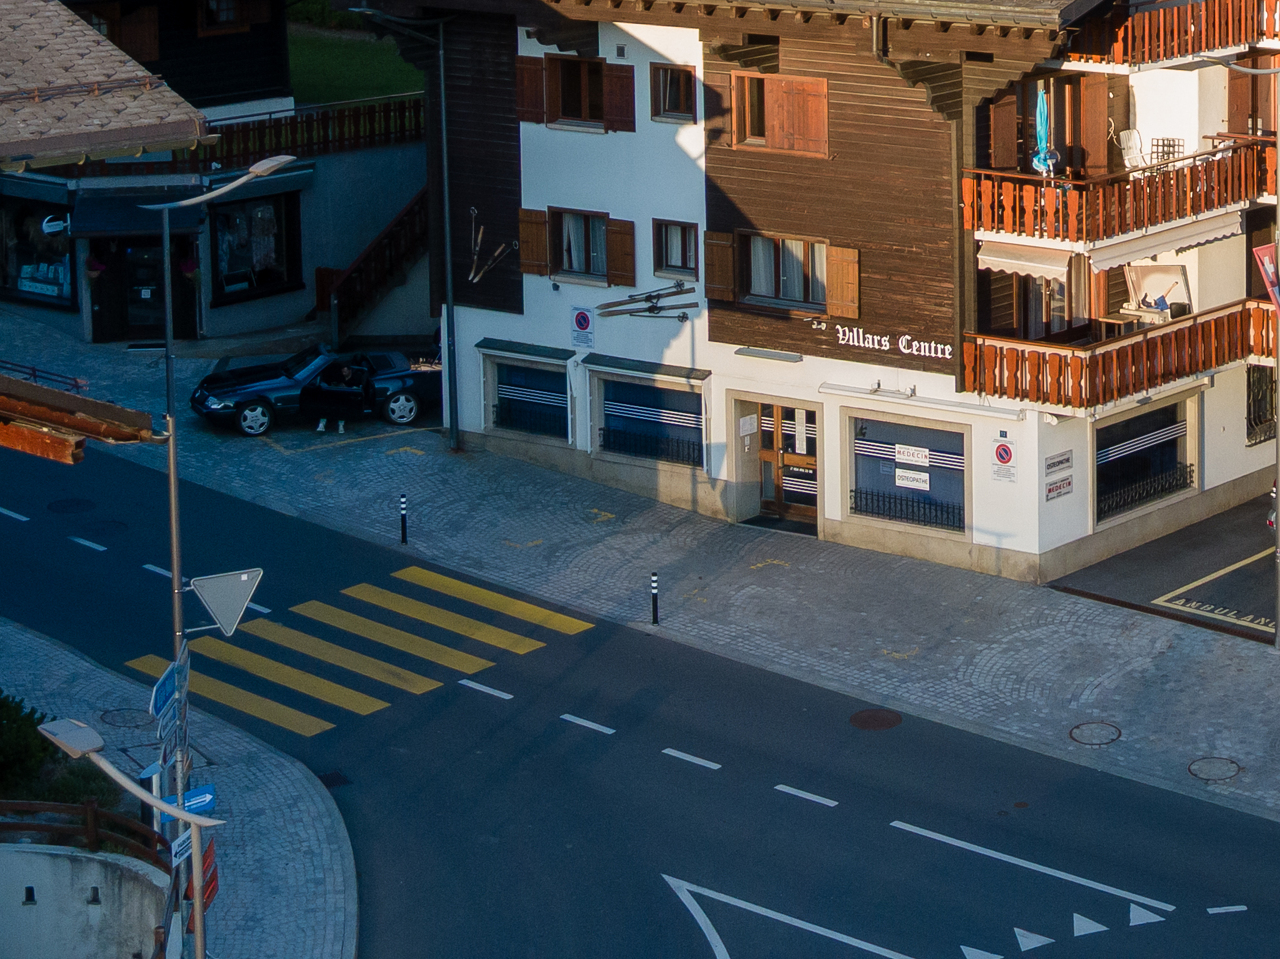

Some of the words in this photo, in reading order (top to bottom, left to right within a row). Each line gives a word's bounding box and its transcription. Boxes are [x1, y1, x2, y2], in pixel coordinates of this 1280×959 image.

[835, 324, 890, 351] Villars
[898, 334, 953, 359] Centre
[896, 449, 928, 460] MEDECIN
[896, 474, 928, 485] OSTEOPATHE
[1047, 480, 1072, 494] MEDECIN
